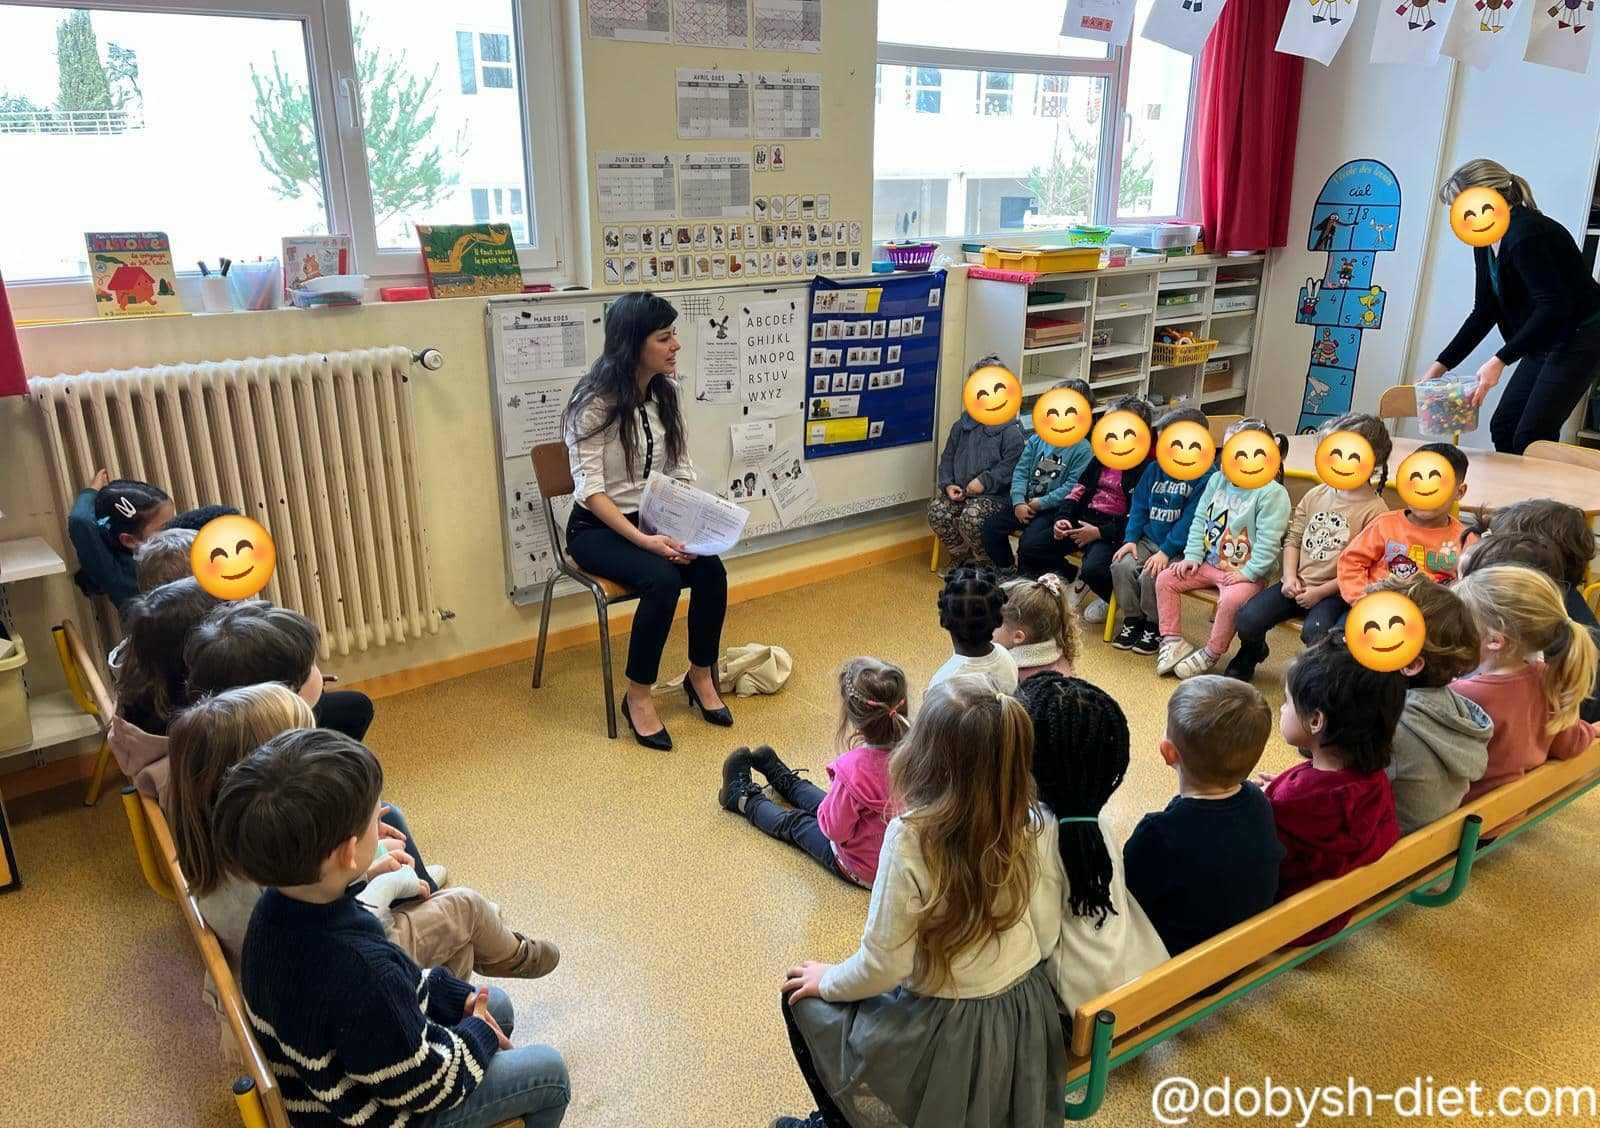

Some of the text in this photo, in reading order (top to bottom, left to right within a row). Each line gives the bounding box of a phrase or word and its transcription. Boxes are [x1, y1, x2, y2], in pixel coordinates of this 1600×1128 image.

[1349, 184, 1372, 197] ciel
[1362, 208, 1369, 219] 8
[1361, 255, 1369, 266] 6
[717, 295, 725, 311] 2
[1330, 294, 1351, 323] 4 5
[1348, 333, 1355, 344] 3
[1340, 375, 1347, 386] 2
